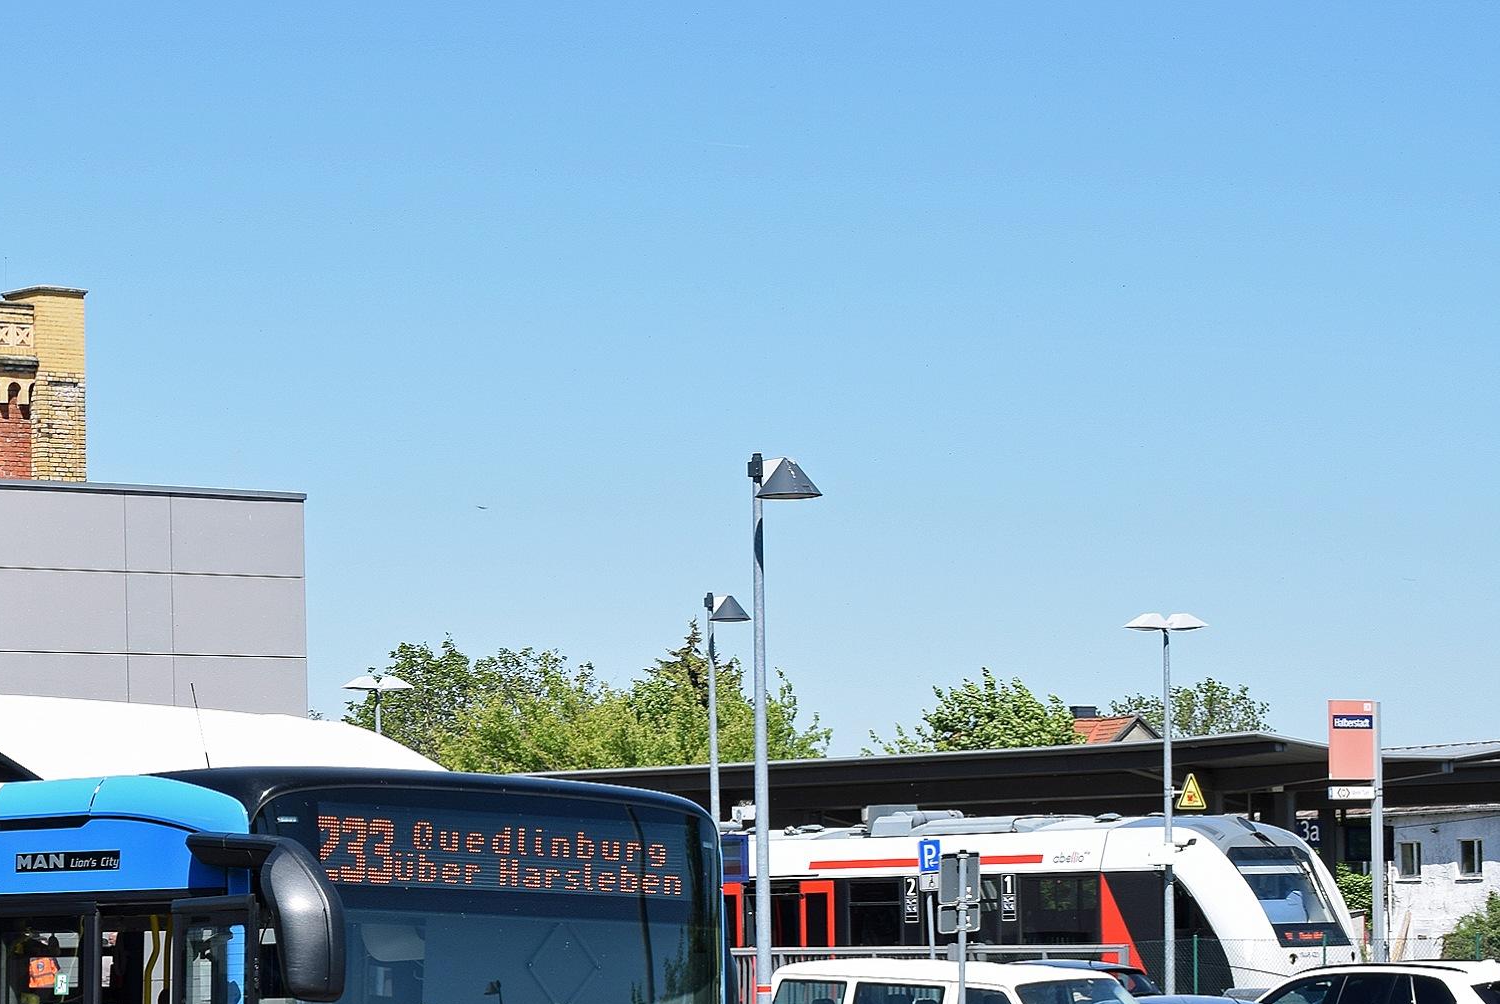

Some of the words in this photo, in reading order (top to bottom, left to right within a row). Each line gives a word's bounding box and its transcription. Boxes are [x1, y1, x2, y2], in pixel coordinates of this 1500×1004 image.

[1333, 717, 1371, 728] Halberstadt
[1300, 820, 1320, 842] 3a
[412, 820, 667, 868] Quedlinburg
[16, 853, 65, 870] MAN
[70, 858, 98, 868] Lion's
[100, 857, 120, 869] City
[394, 850, 481, 886] über
[499, 857, 683, 897] Harsleben
[905, 877, 917, 897] 2
[1003, 874, 1013, 894] 1
